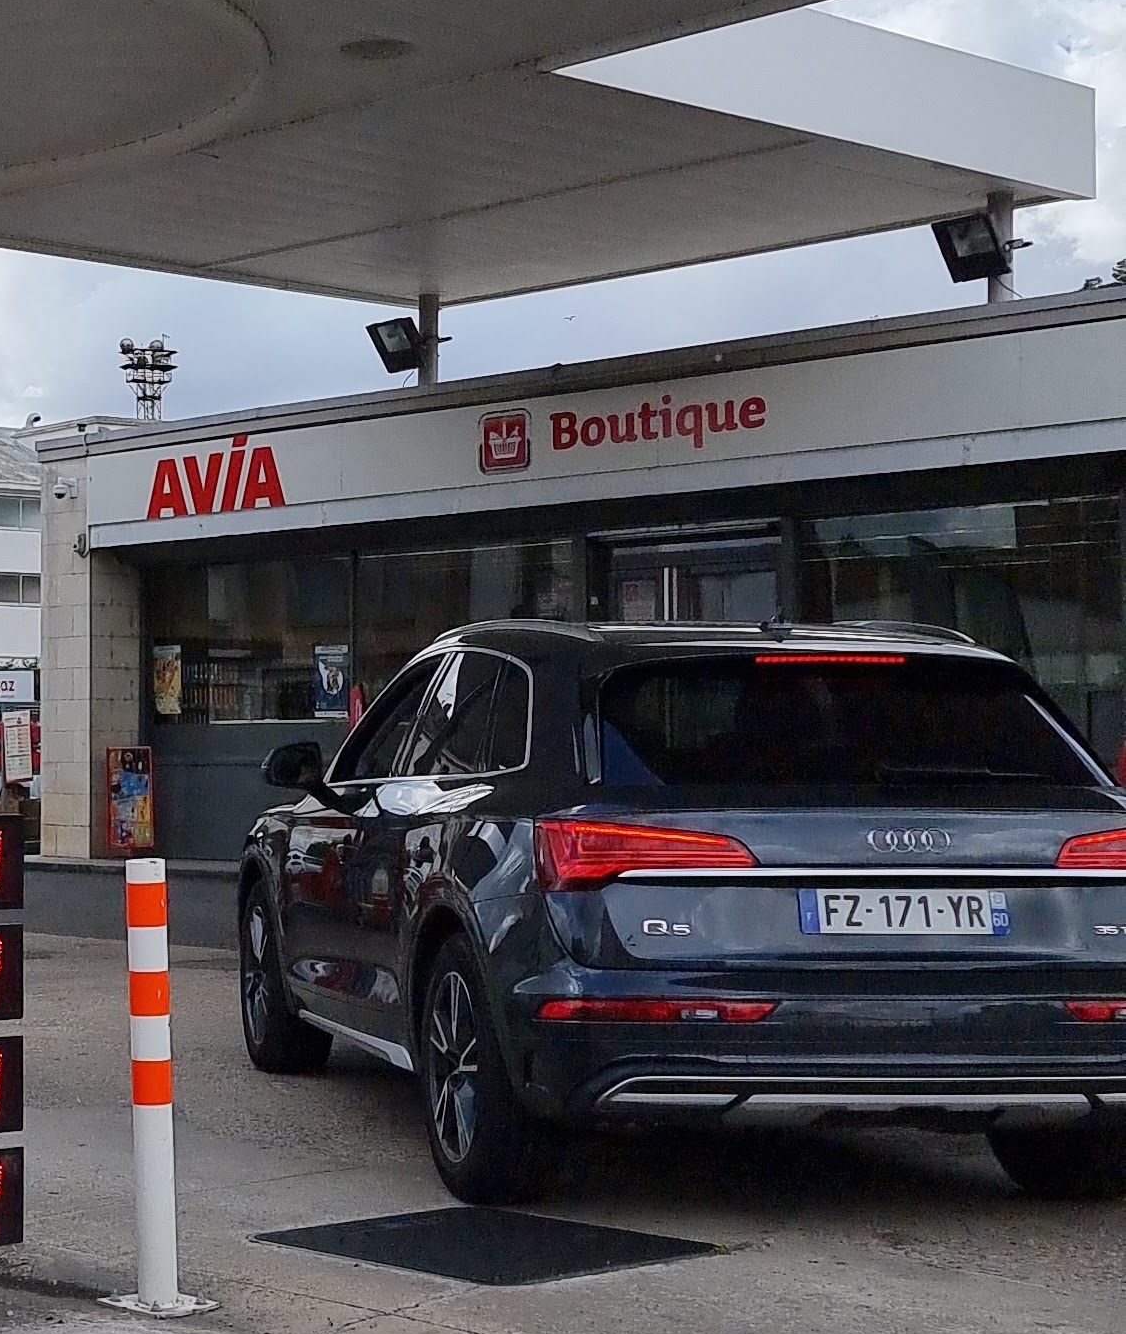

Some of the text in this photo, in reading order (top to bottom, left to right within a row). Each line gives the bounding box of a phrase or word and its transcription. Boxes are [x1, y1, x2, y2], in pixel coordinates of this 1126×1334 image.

[549, 394, 767, 451] Boutique
[824, 895, 986, 927] FZ-171-YR
[992, 912, 1009, 927] 60
[643, 919, 692, 936] Q5
